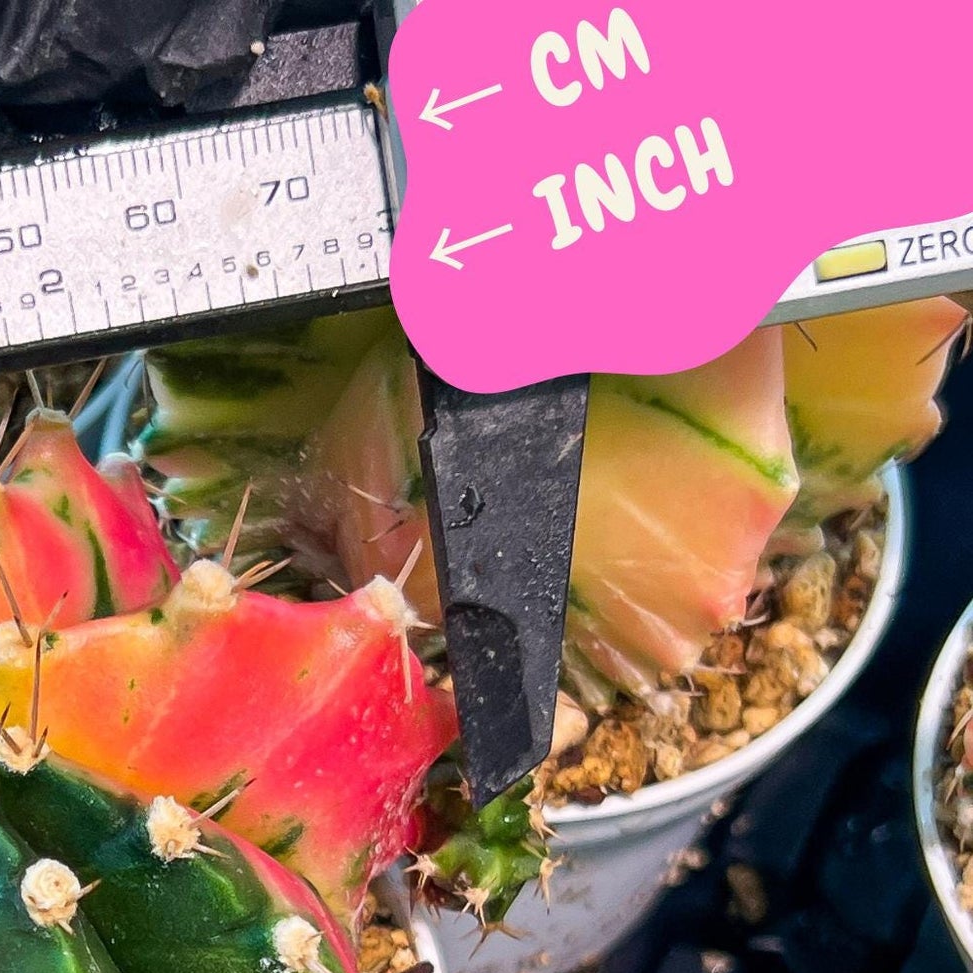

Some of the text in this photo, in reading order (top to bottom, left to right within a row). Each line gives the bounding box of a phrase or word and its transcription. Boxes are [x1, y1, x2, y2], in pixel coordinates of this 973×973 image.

[126, 199, 177, 231] 60
[260, 176, 309, 206] 70
[20, 293, 36, 310] 9
[39, 268, 65, 294] 2
[95, 280, 102, 296] 1
[121, 274, 137, 292] 2
[154, 268, 170, 284] 3
[187, 262, 203, 280] 4
[222, 256, 237, 273] 5
[256, 251, 271, 267] 6
[293, 244, 305, 261] 7
[323, 238, 340, 255] 8
[357, 232, 373, 250] 9
